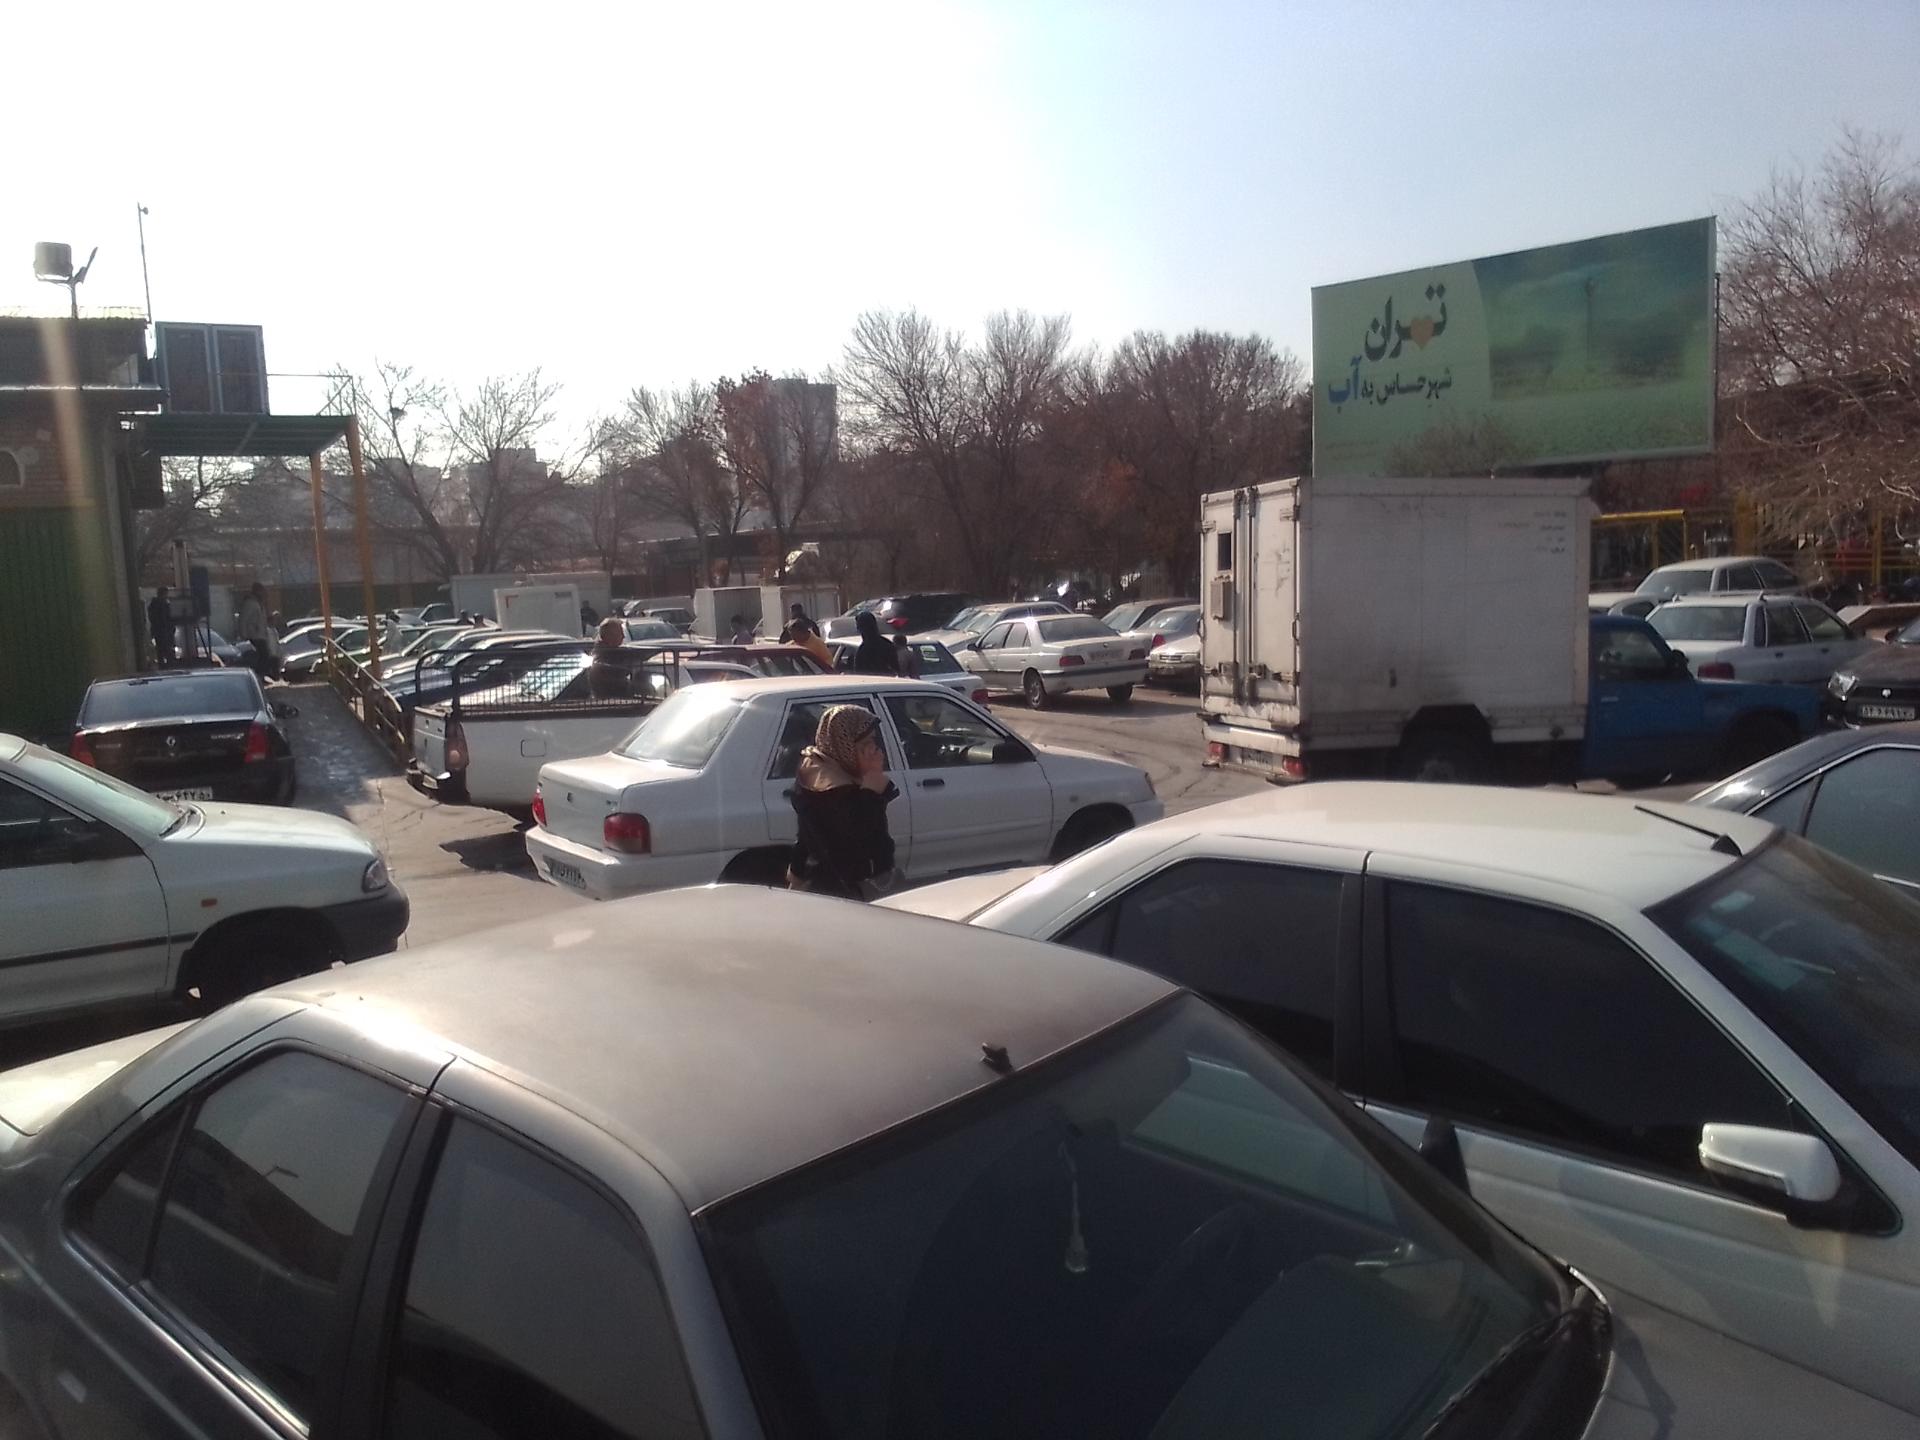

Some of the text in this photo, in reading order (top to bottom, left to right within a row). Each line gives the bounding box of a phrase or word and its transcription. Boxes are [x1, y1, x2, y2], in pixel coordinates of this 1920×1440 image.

[1364, 283, 1448, 361] تران
[1328, 355, 1452, 414] شهر حساس به آب
